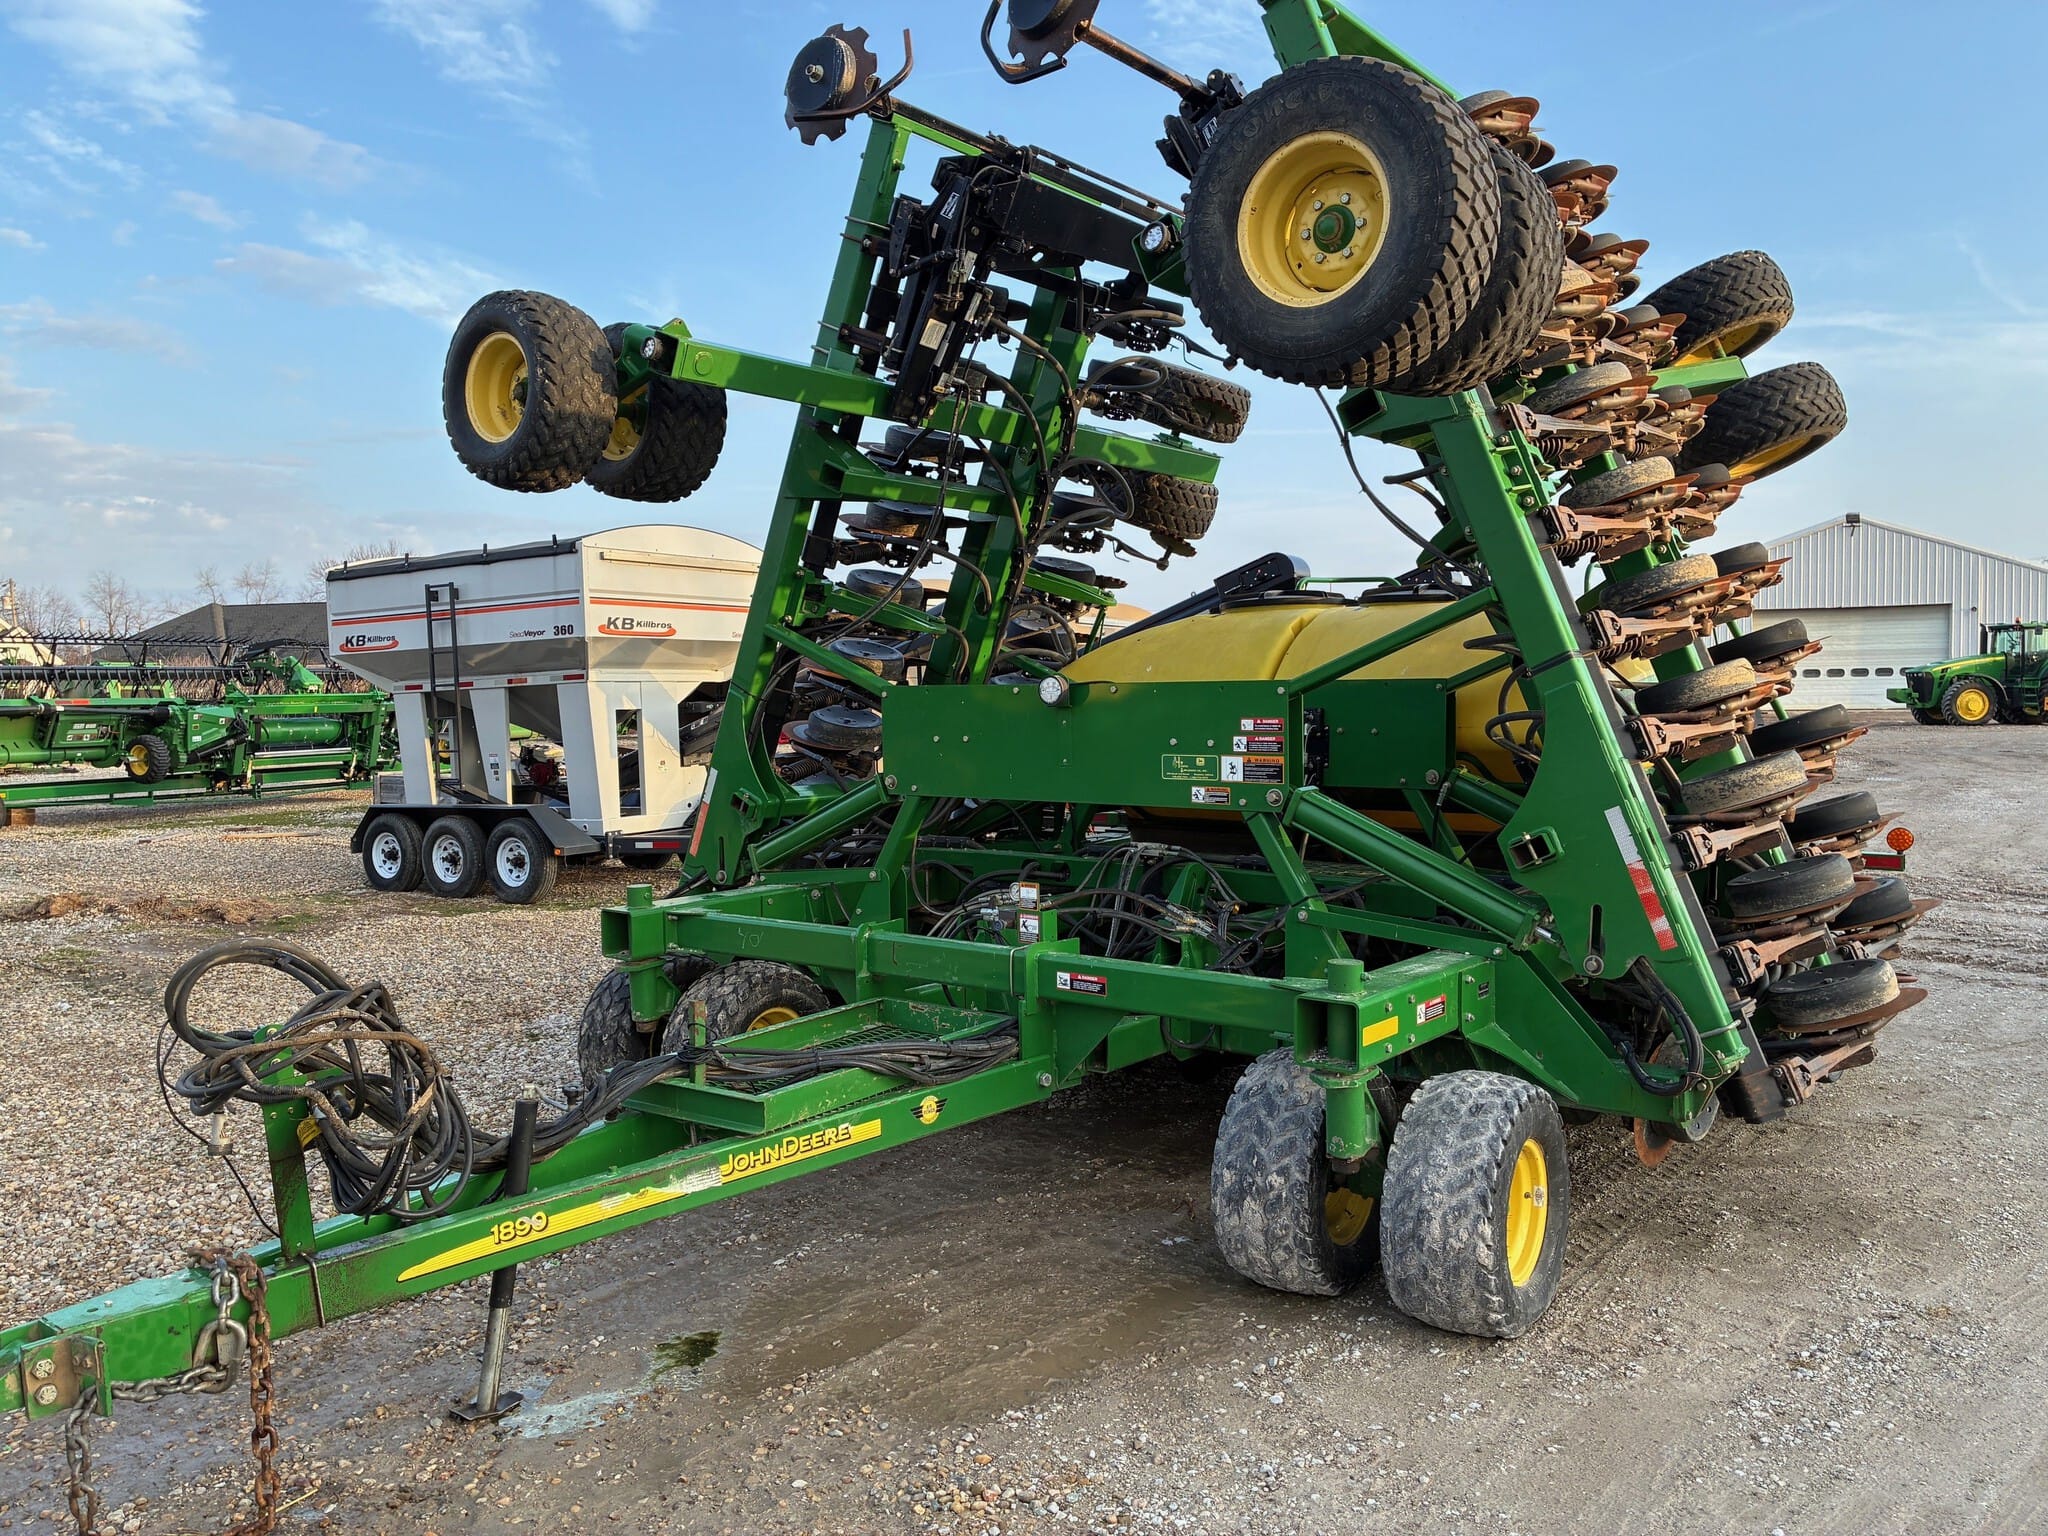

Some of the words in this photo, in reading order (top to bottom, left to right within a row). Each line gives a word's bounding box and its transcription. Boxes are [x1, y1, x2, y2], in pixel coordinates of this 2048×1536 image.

[553, 624, 574, 636] 360
[606, 617, 635, 630] KB
[636, 620, 672, 629] Killbros
[345, 635, 366, 647] KB
[720, 1144, 781, 1176] JOHN
[782, 1122, 850, 1157] DEERE
[490, 1211, 548, 1245] 1890
